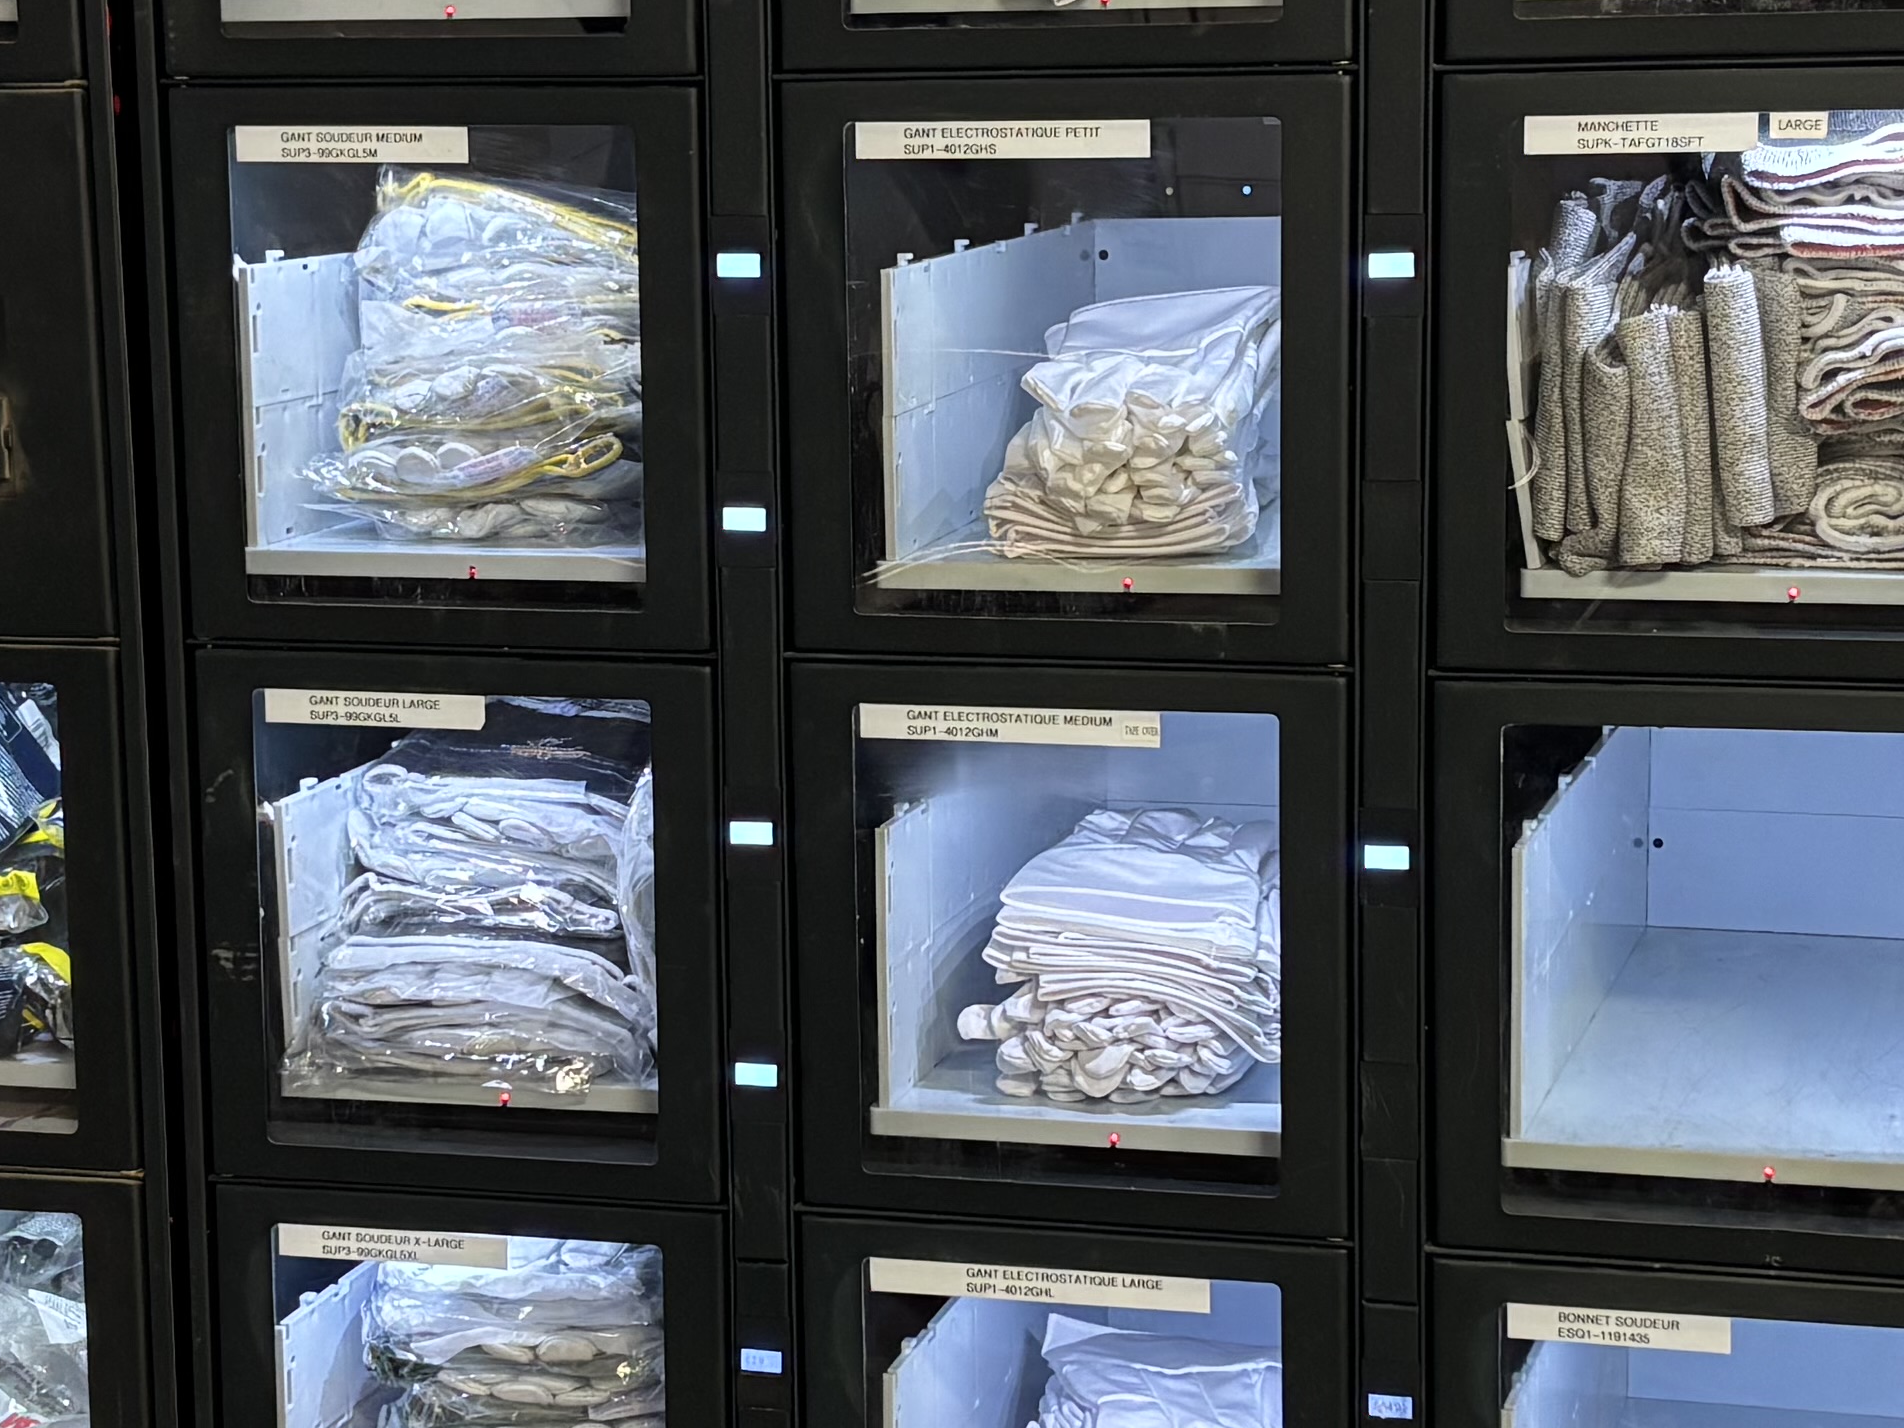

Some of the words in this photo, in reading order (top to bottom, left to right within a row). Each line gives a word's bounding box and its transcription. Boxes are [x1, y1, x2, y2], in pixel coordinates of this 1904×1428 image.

[1577, 120, 1659, 132] MANCHETTE
[1778, 119, 1824, 130] LARGE
[280, 131, 313, 143] GANT
[315, 132, 373, 143] SOUDEUR
[375, 132, 423, 143] MEDIUM
[903, 127, 938, 139] GANT
[940, 127, 1061, 138] ELECTROSTATIQUE
[1065, 126, 1101, 138] PETIT
[308, 695, 340, 705] GANT
[343, 696, 400, 708] SOUDEUR
[402, 699, 441, 710] LARGE
[906, 709, 939, 720] GANT
[943, 711, 1060, 724] ELECTROSTATIQUE
[1063, 715, 1113, 726] MEDIUM
[321, 1230, 352, 1241] GANT
[355, 1232, 411, 1245] SOUDEUR
[413, 1237, 465, 1249] X-LARGE
[965, 1267, 999, 1278] GANT
[1002, 1270, 1118, 1287] ELECTROSTATIQUE
[1121, 1278, 1163, 1290] LARGE
[1558, 1311, 1611, 1325] BONNET
[1614, 1316, 1680, 1330] SOUDEUR
